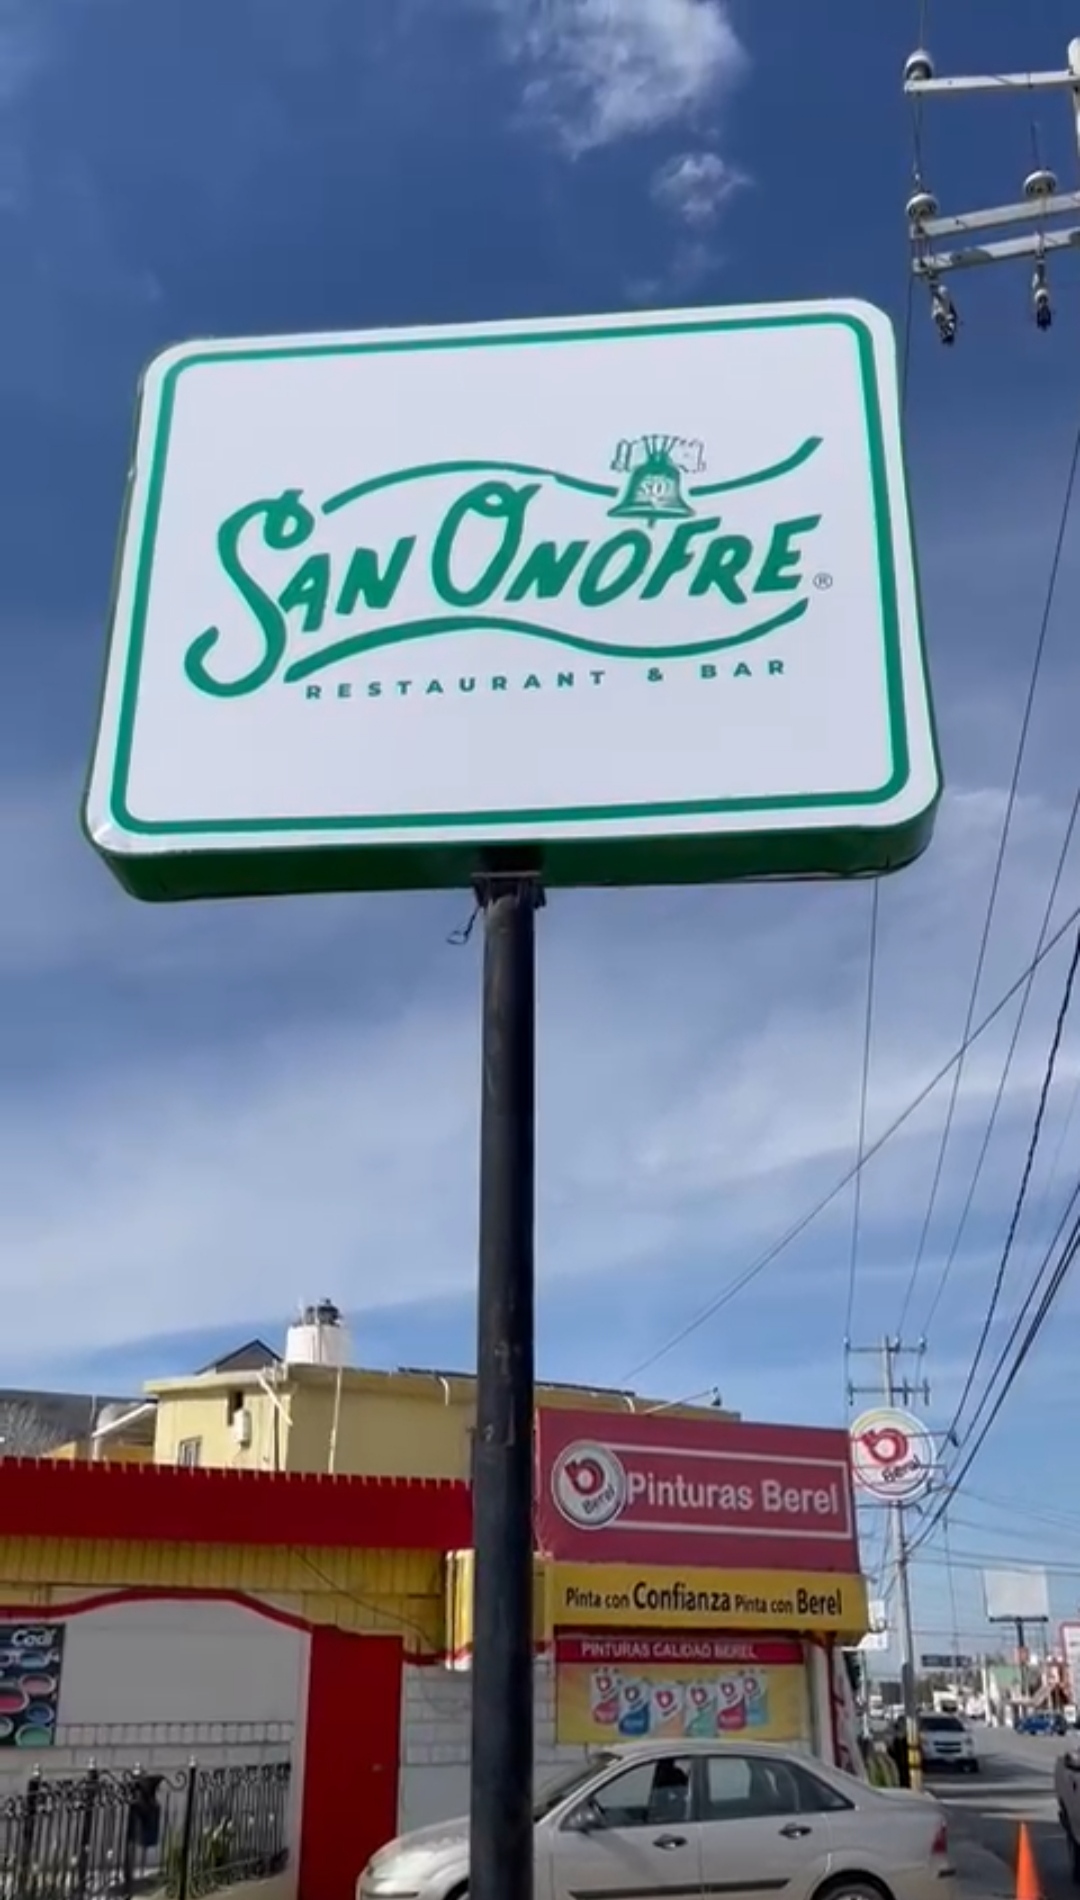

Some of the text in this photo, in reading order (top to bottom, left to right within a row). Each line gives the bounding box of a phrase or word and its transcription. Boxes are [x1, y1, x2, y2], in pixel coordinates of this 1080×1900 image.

[305, 659, 786, 700] RESTAURANT & BAR
[627, 1472, 839, 1515] Pinturas Berel
[566, 1581, 843, 1616] Pinta con Confianza Pinta con Berel
[581, 1642, 758, 1660] PINTURAS CALIDAD BEREL
